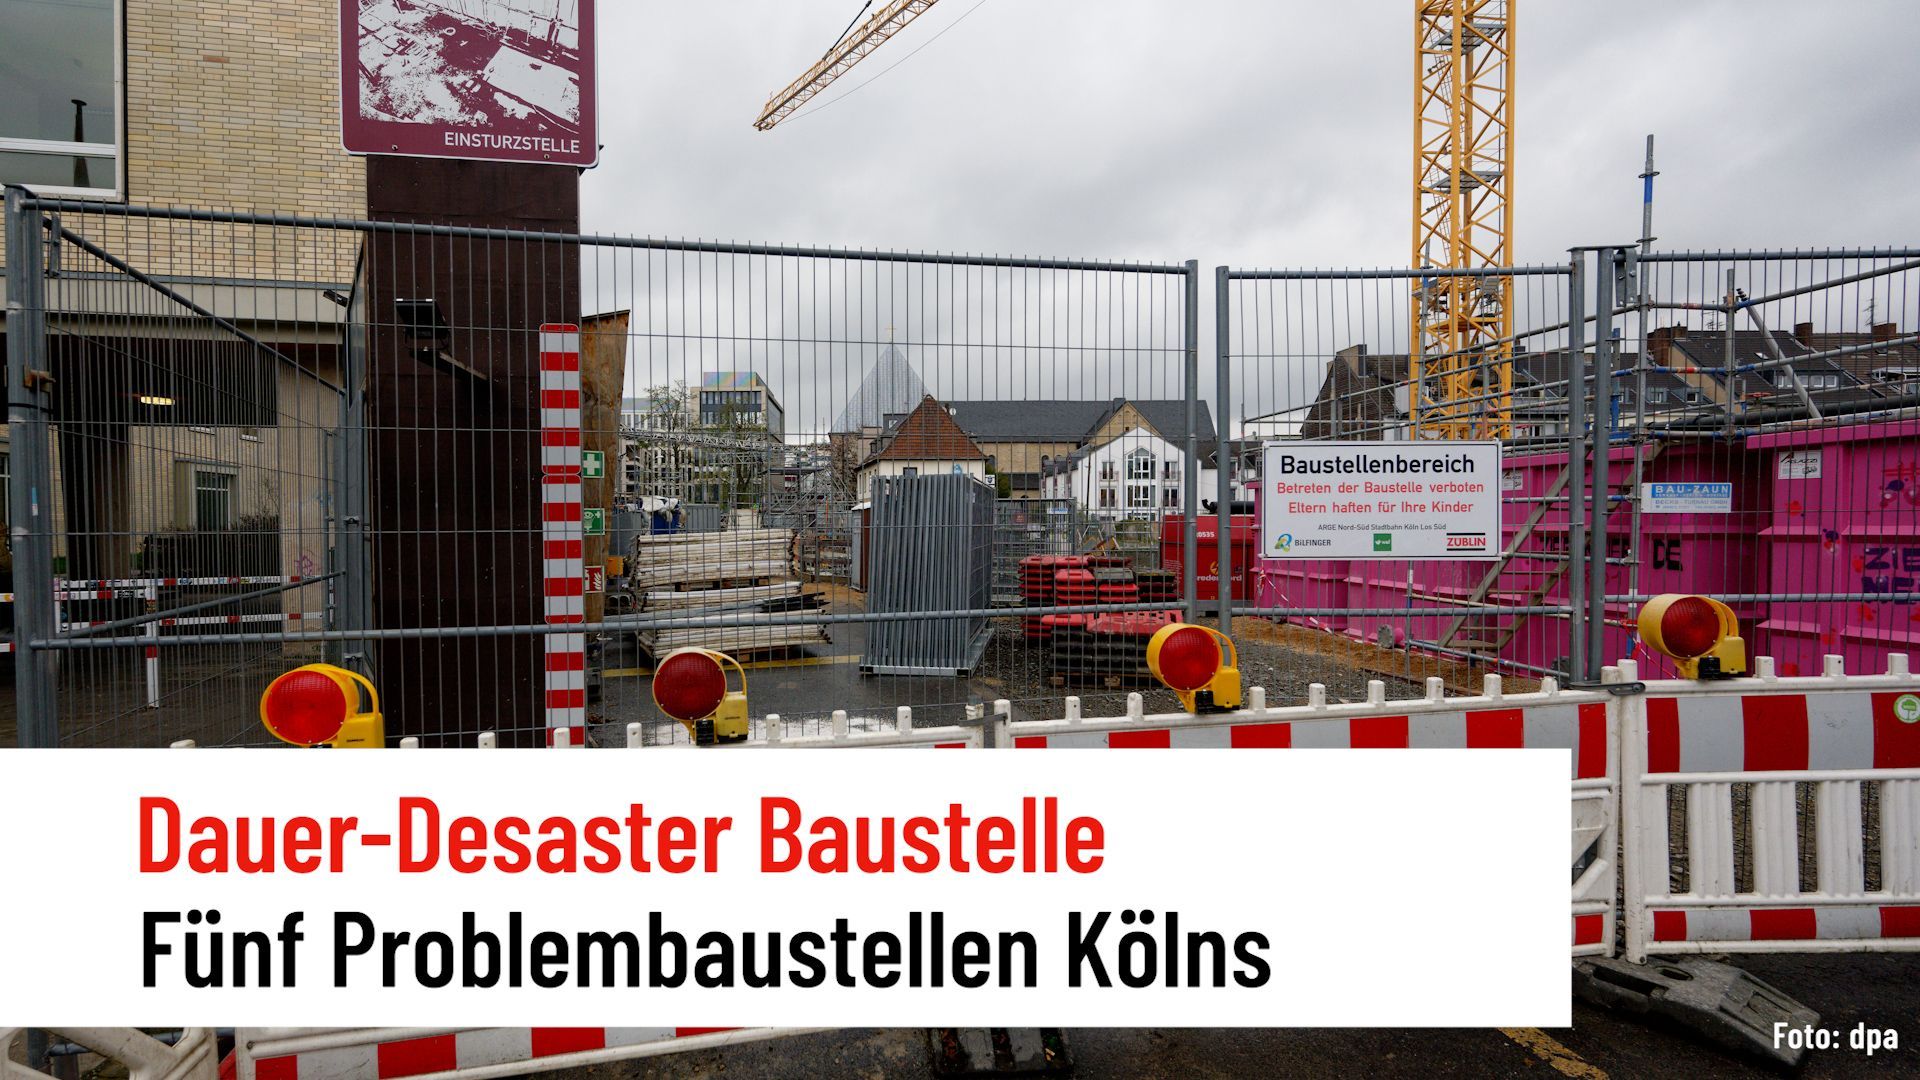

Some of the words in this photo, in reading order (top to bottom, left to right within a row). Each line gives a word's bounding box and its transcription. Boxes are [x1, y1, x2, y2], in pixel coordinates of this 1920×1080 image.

[444, 131, 580, 154] EINSTURZSTELLE
[1281, 454, 1474, 474] Baustellenbereich
[1278, 482, 1331, 494] Betreten
[1338, 482, 1359, 493] der
[1364, 481, 1423, 493] Baustelle
[1429, 482, 1484, 493] verboten
[1655, 485, 1728, 494] BAU-ZAUN
[1288, 501, 1327, 513] Eltern
[1332, 501, 1372, 513] haften
[1378, 501, 1396, 513] für
[1401, 501, 1426, 512] Ihre
[1432, 501, 1473, 513] Kinder
[1337, 523, 1370, 531] Nord-Süd
[1370, 523, 1403, 531] Stadtbahn
[1404, 523, 1419, 531] Köln
[1420, 523, 1432, 531] Los
[1433, 523, 1447, 531] Süd
[1447, 537, 1486, 547] ZÜBLIN
